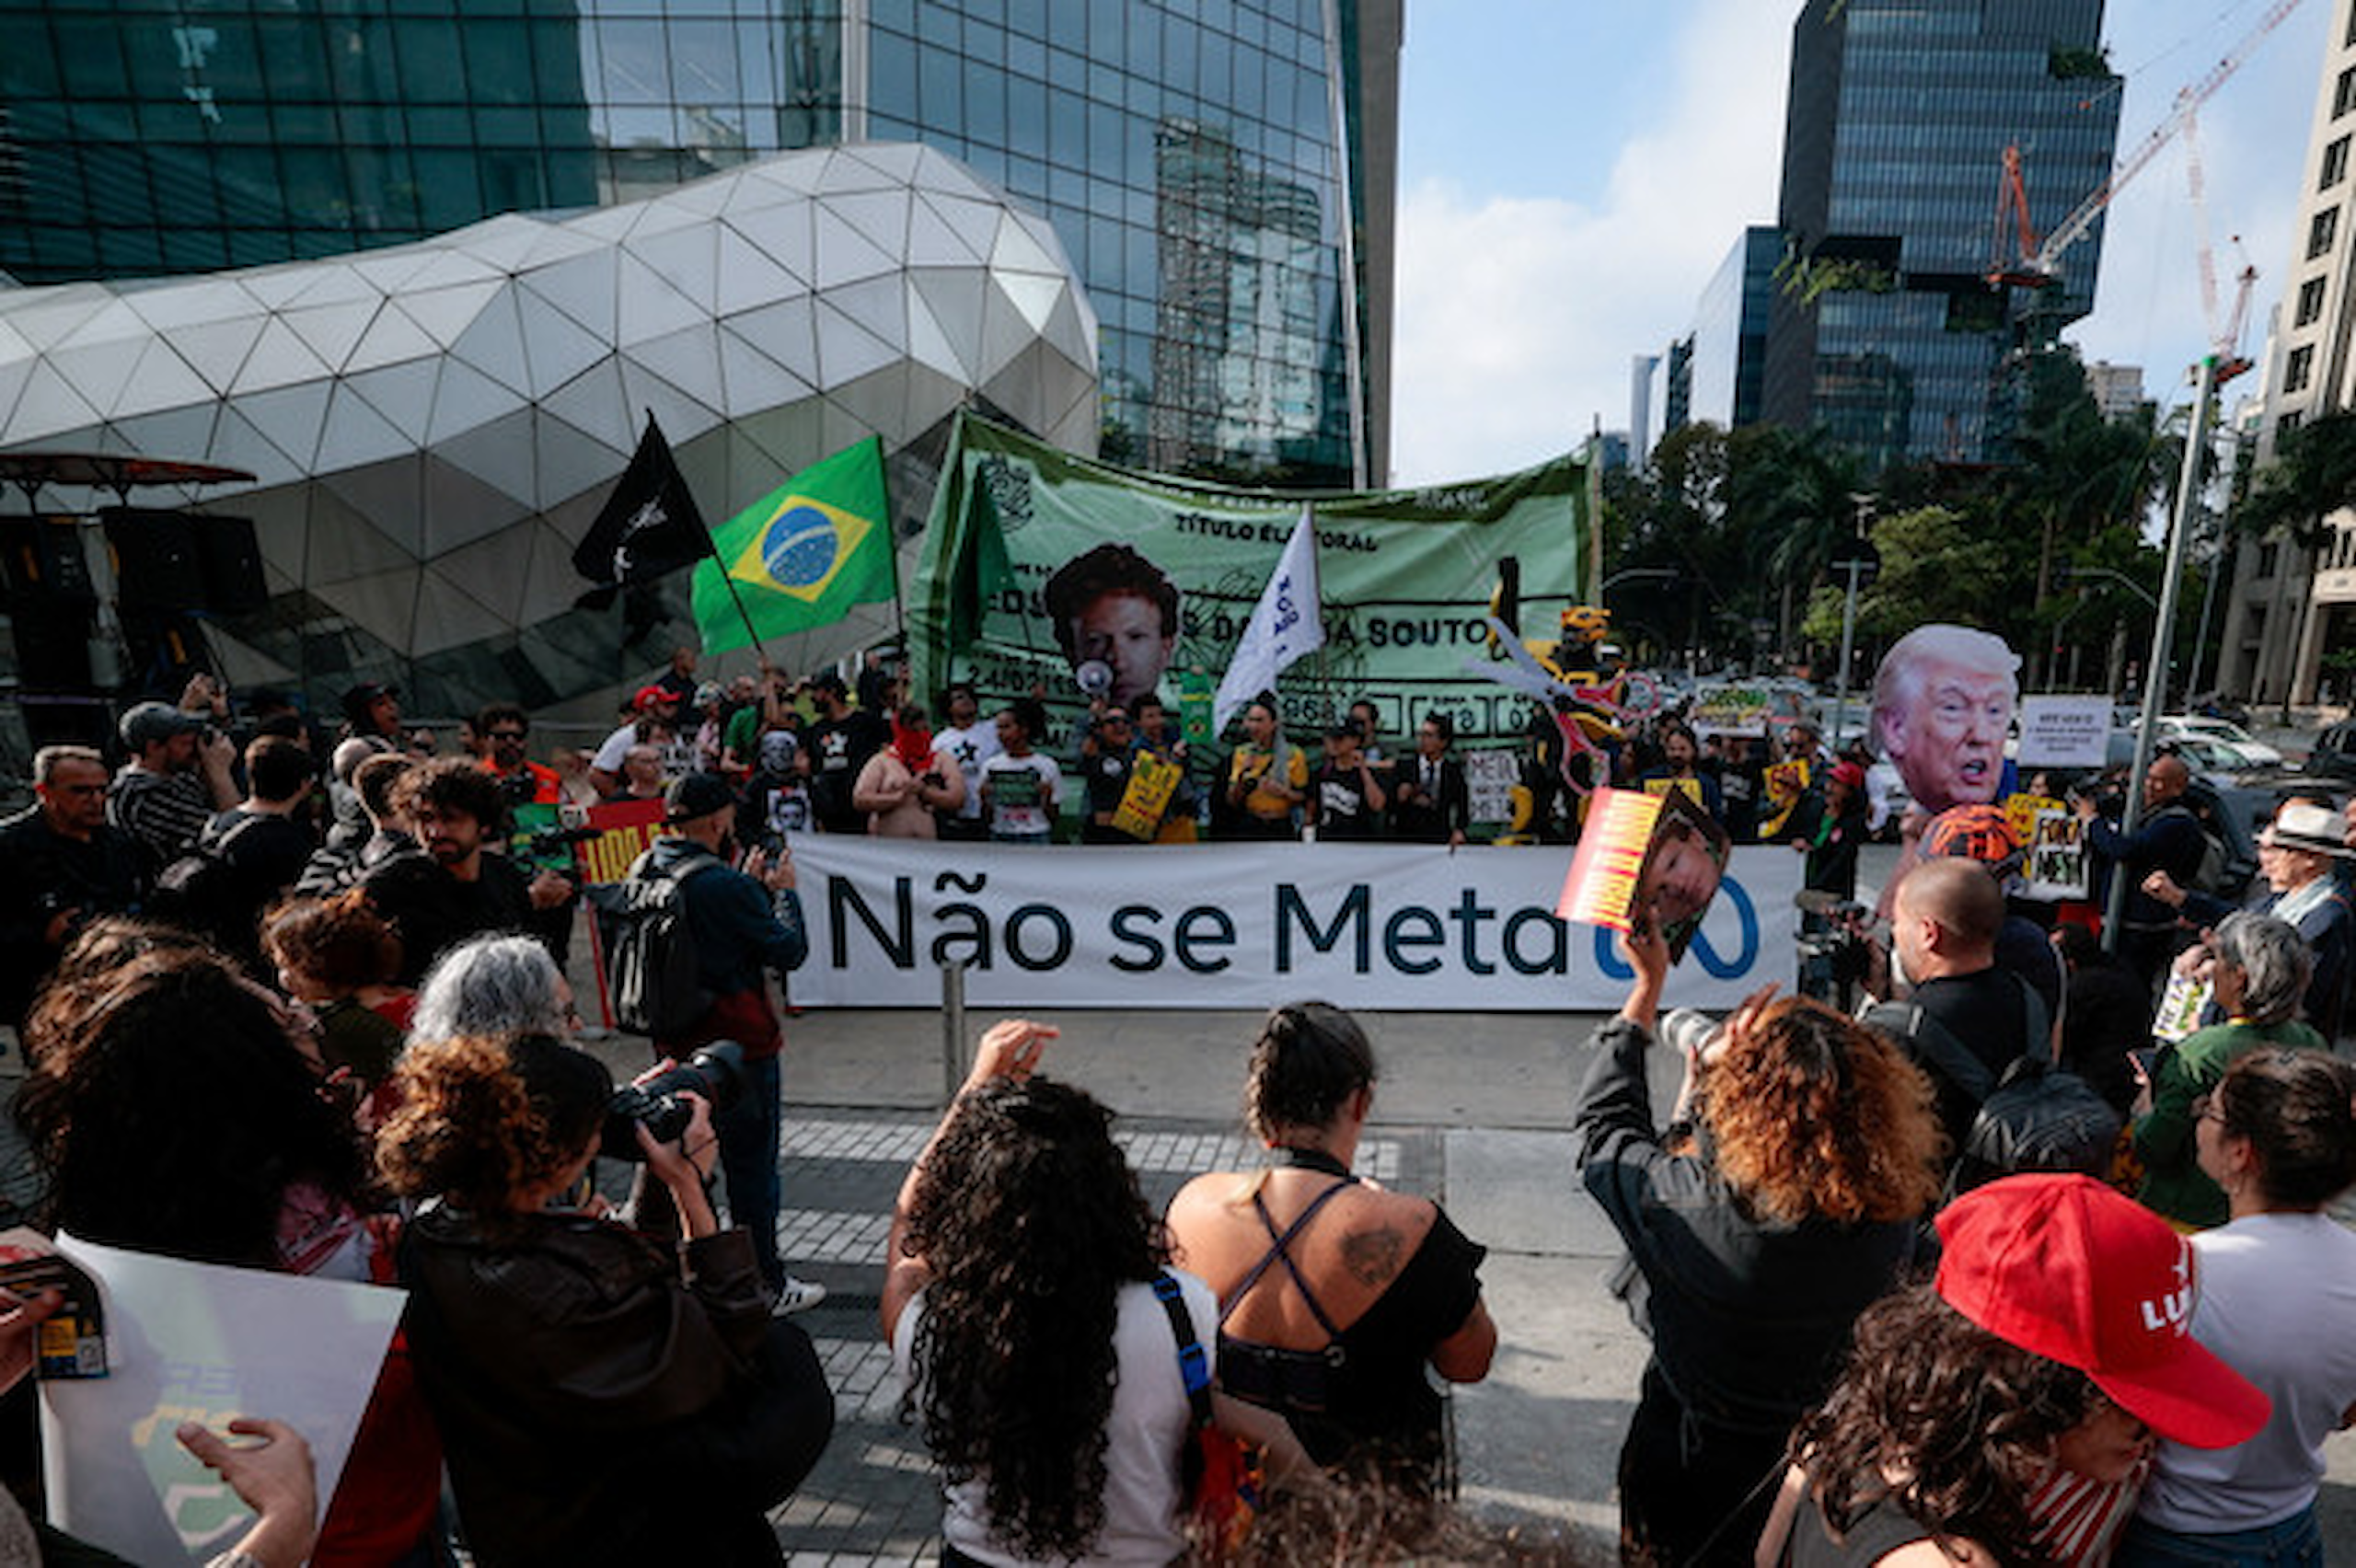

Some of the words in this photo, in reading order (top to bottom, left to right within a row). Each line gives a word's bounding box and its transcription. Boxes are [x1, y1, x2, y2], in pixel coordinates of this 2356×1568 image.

[1174, 513, 1254, 540] TÍTULO
[1367, 618, 1488, 648] SOUTO
[828, 870, 1074, 971] Não
[1109, 904, 1236, 972] se
[1275, 883, 1568, 975] Meta
